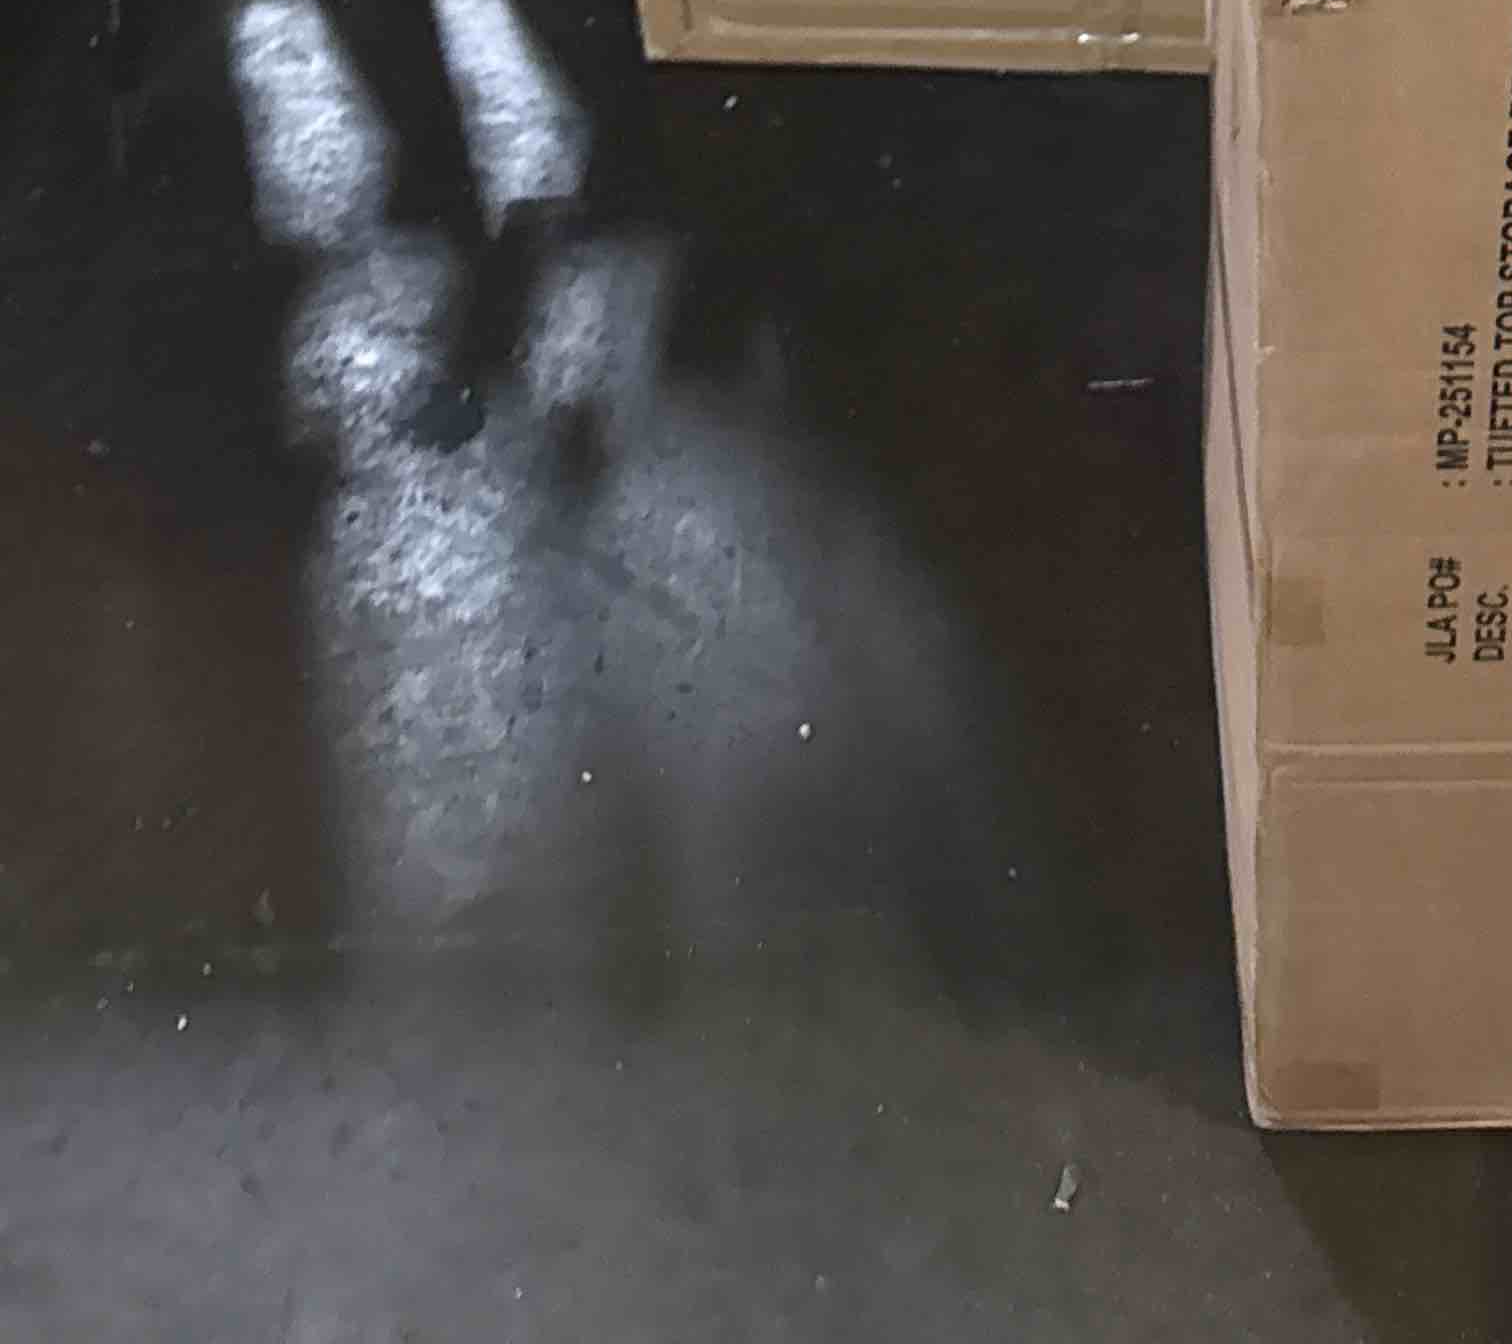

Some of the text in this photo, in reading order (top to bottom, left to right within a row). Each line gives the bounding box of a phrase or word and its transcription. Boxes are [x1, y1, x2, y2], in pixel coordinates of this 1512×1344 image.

[1435, 324, 1477, 471] MP-251154
[1425, 556, 1461, 662] JLA PO#
[1474, 584, 1509, 662] DESC.
